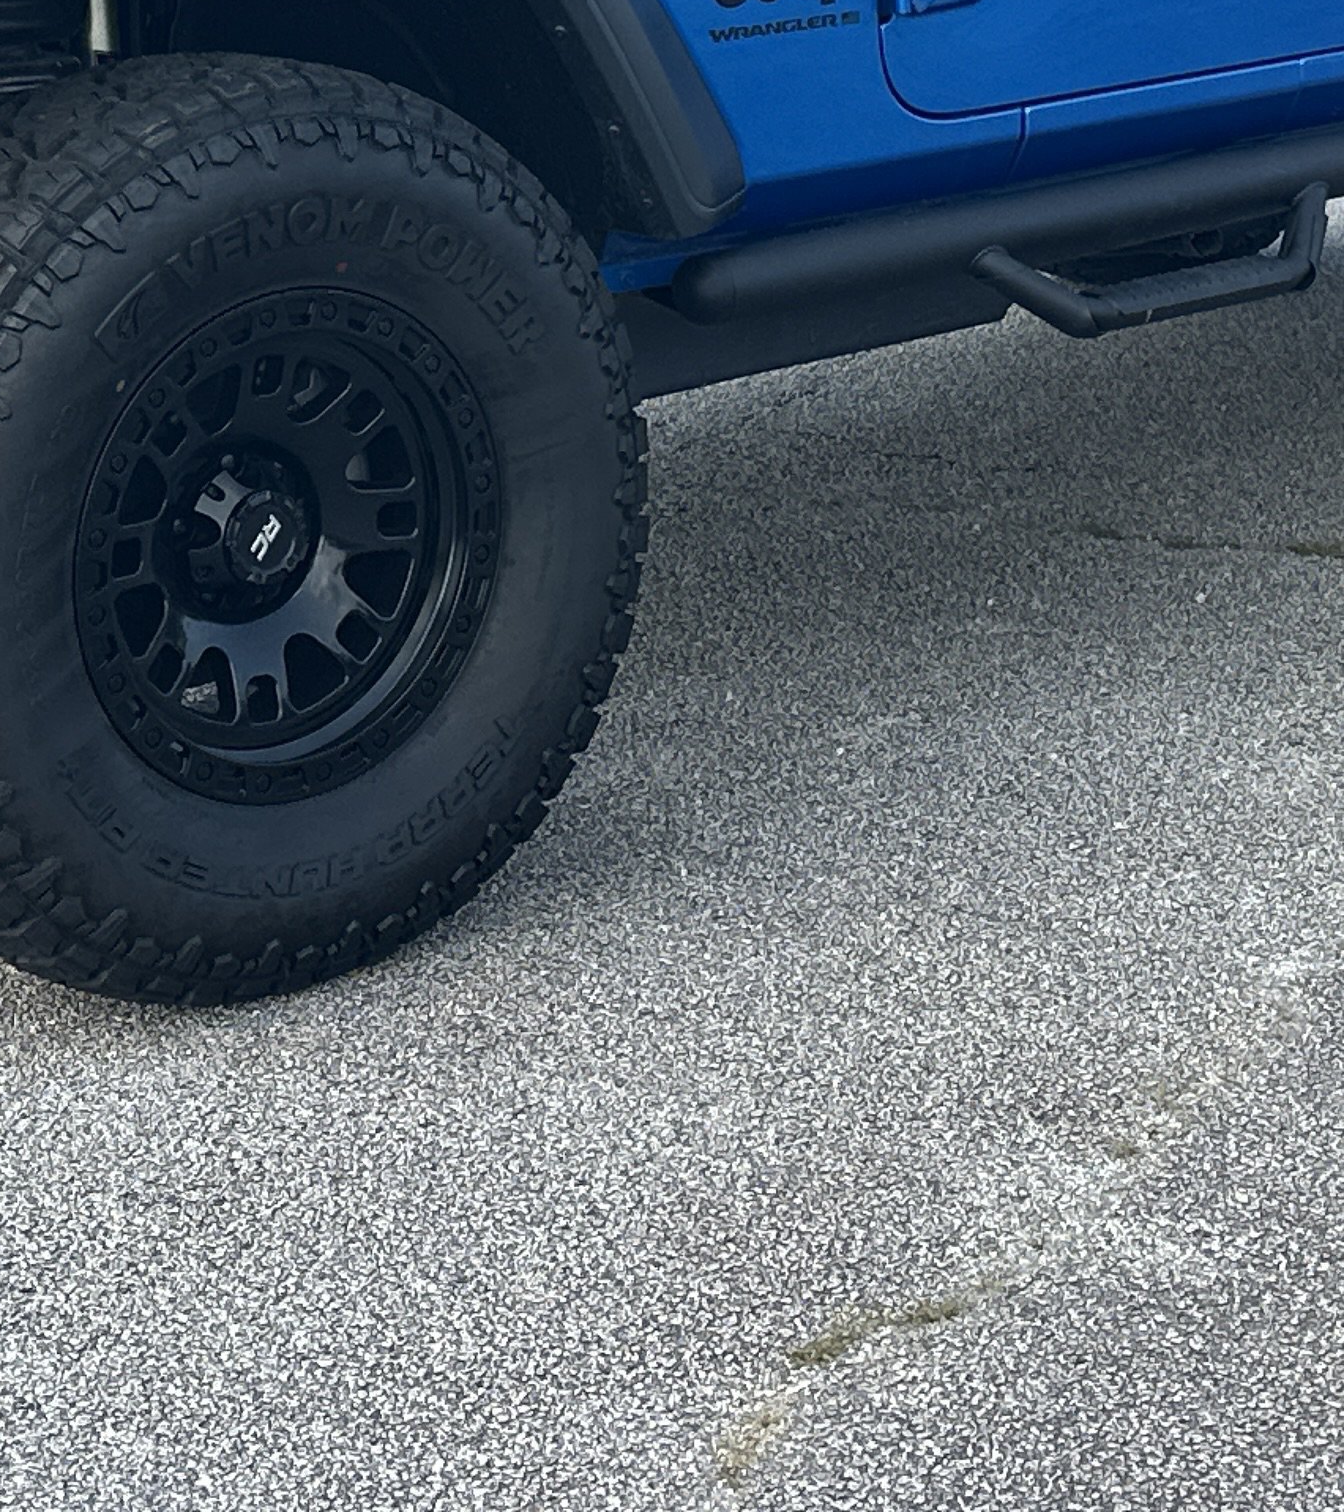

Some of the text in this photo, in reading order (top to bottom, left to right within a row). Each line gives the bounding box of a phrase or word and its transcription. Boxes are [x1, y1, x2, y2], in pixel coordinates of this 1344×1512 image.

[708, 14, 838, 43] WRANGLER
[164, 194, 548, 357] VENOM POWER
[250, 513, 282, 562] RC
